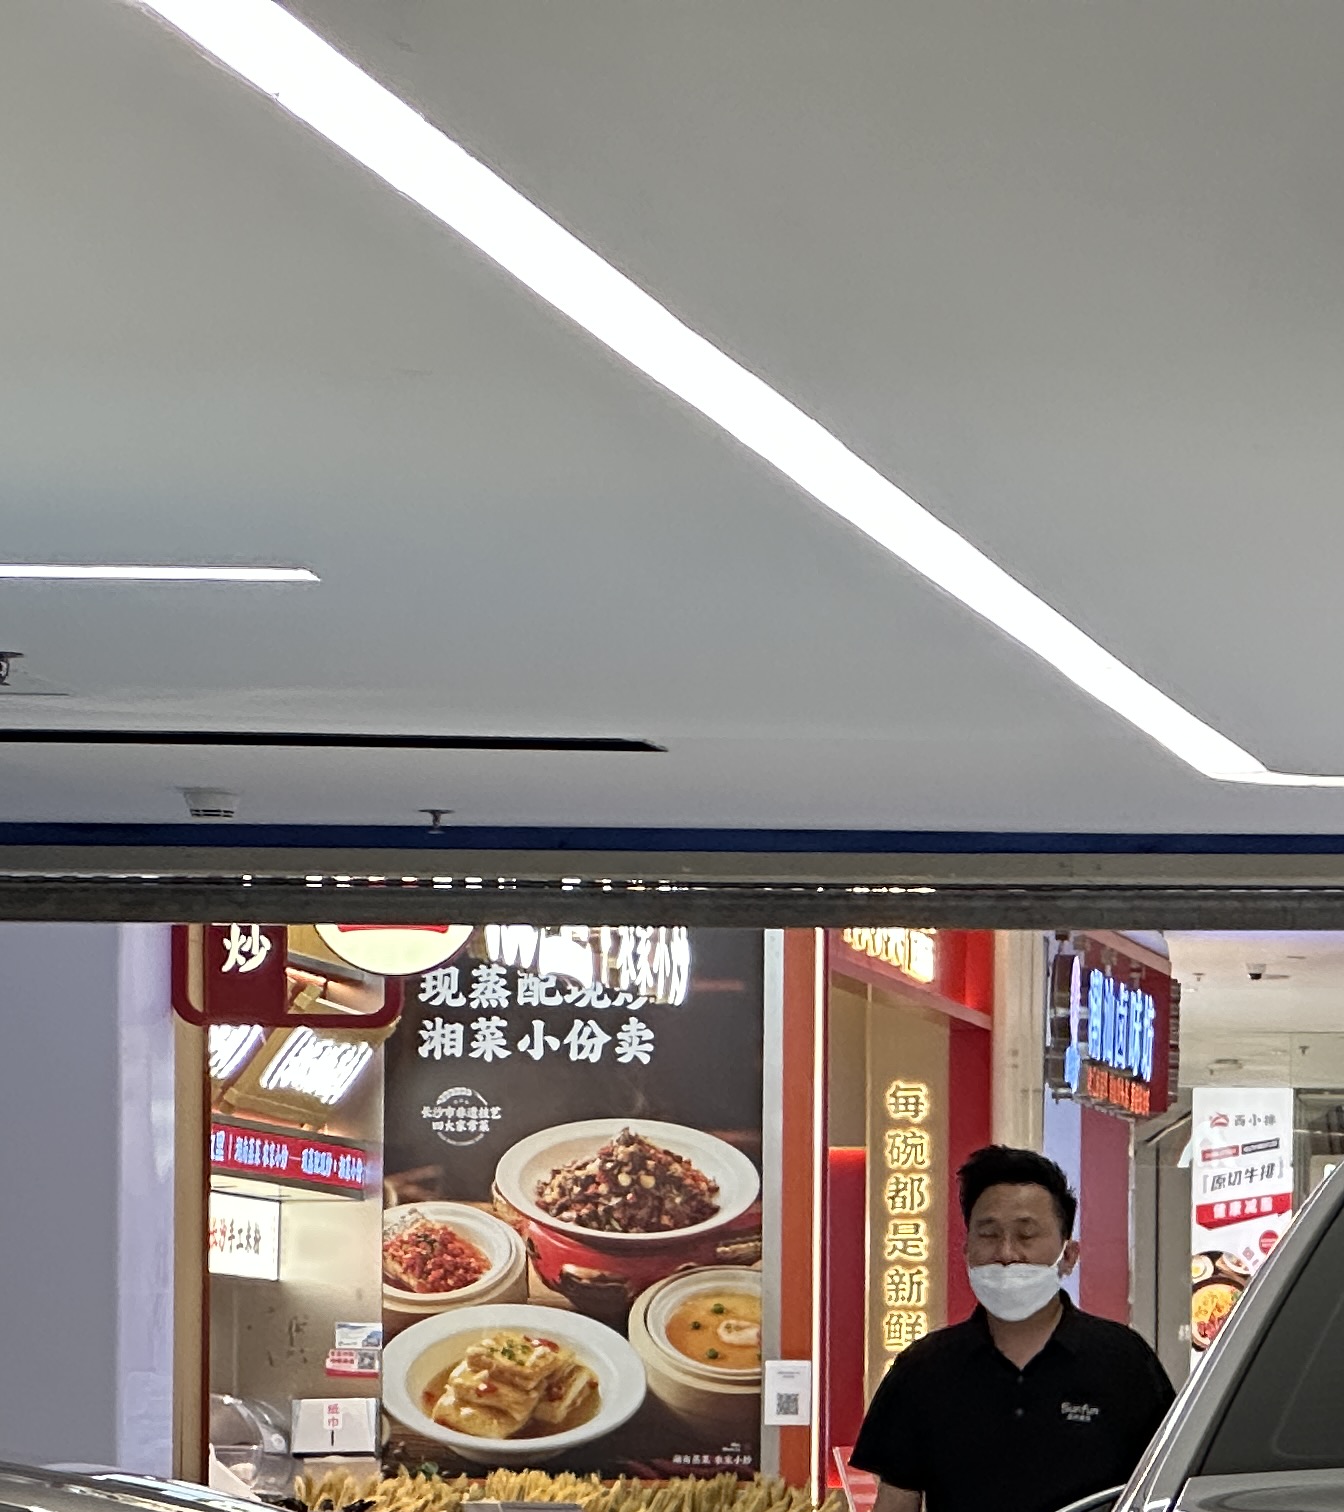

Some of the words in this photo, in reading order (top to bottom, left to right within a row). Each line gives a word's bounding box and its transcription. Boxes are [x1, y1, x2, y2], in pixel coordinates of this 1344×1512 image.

[221, 922, 272, 973] 炒
[418, 1015, 655, 1065] 湘菜小份卖
